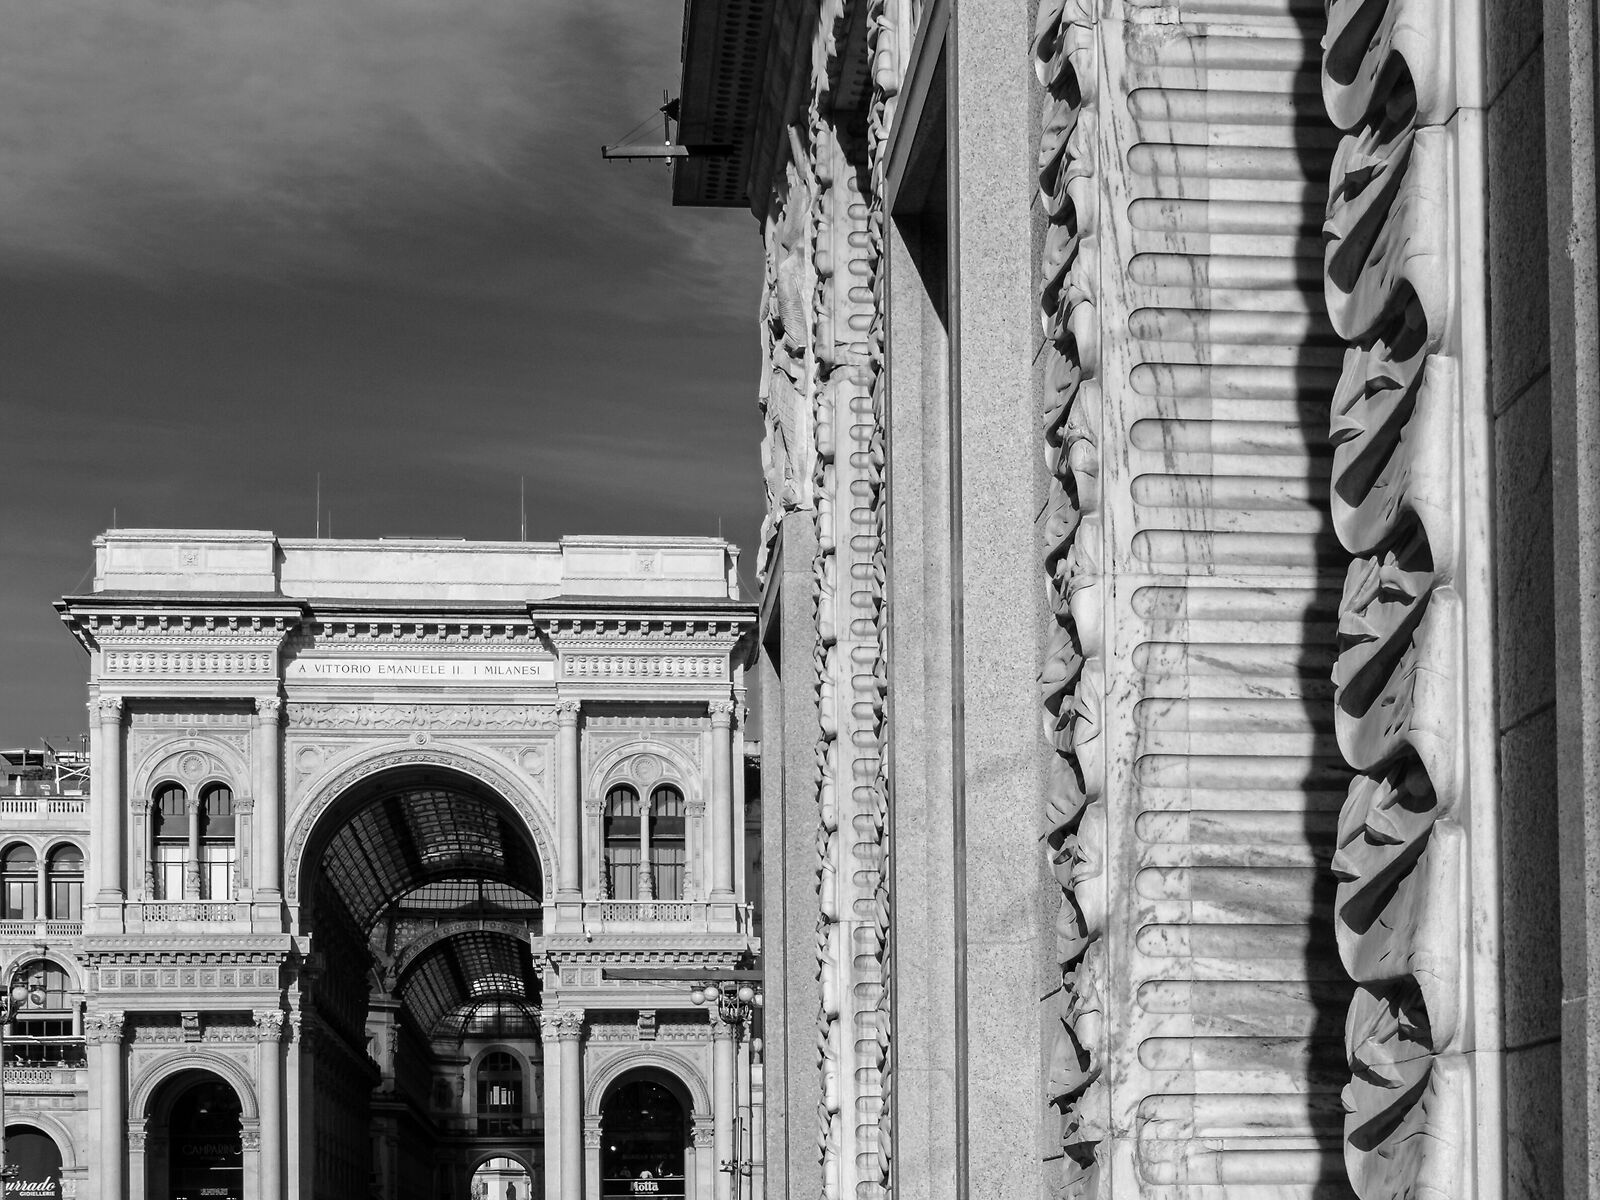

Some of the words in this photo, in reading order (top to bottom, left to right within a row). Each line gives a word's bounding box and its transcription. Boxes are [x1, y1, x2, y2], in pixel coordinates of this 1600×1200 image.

[299, 664, 306, 673] A
[315, 664, 371, 673] VITTORIO
[379, 664, 445, 674] EMANUELE
[485, 665, 540, 675] MILANESI
[629, 1180, 659, 1192] Motta
